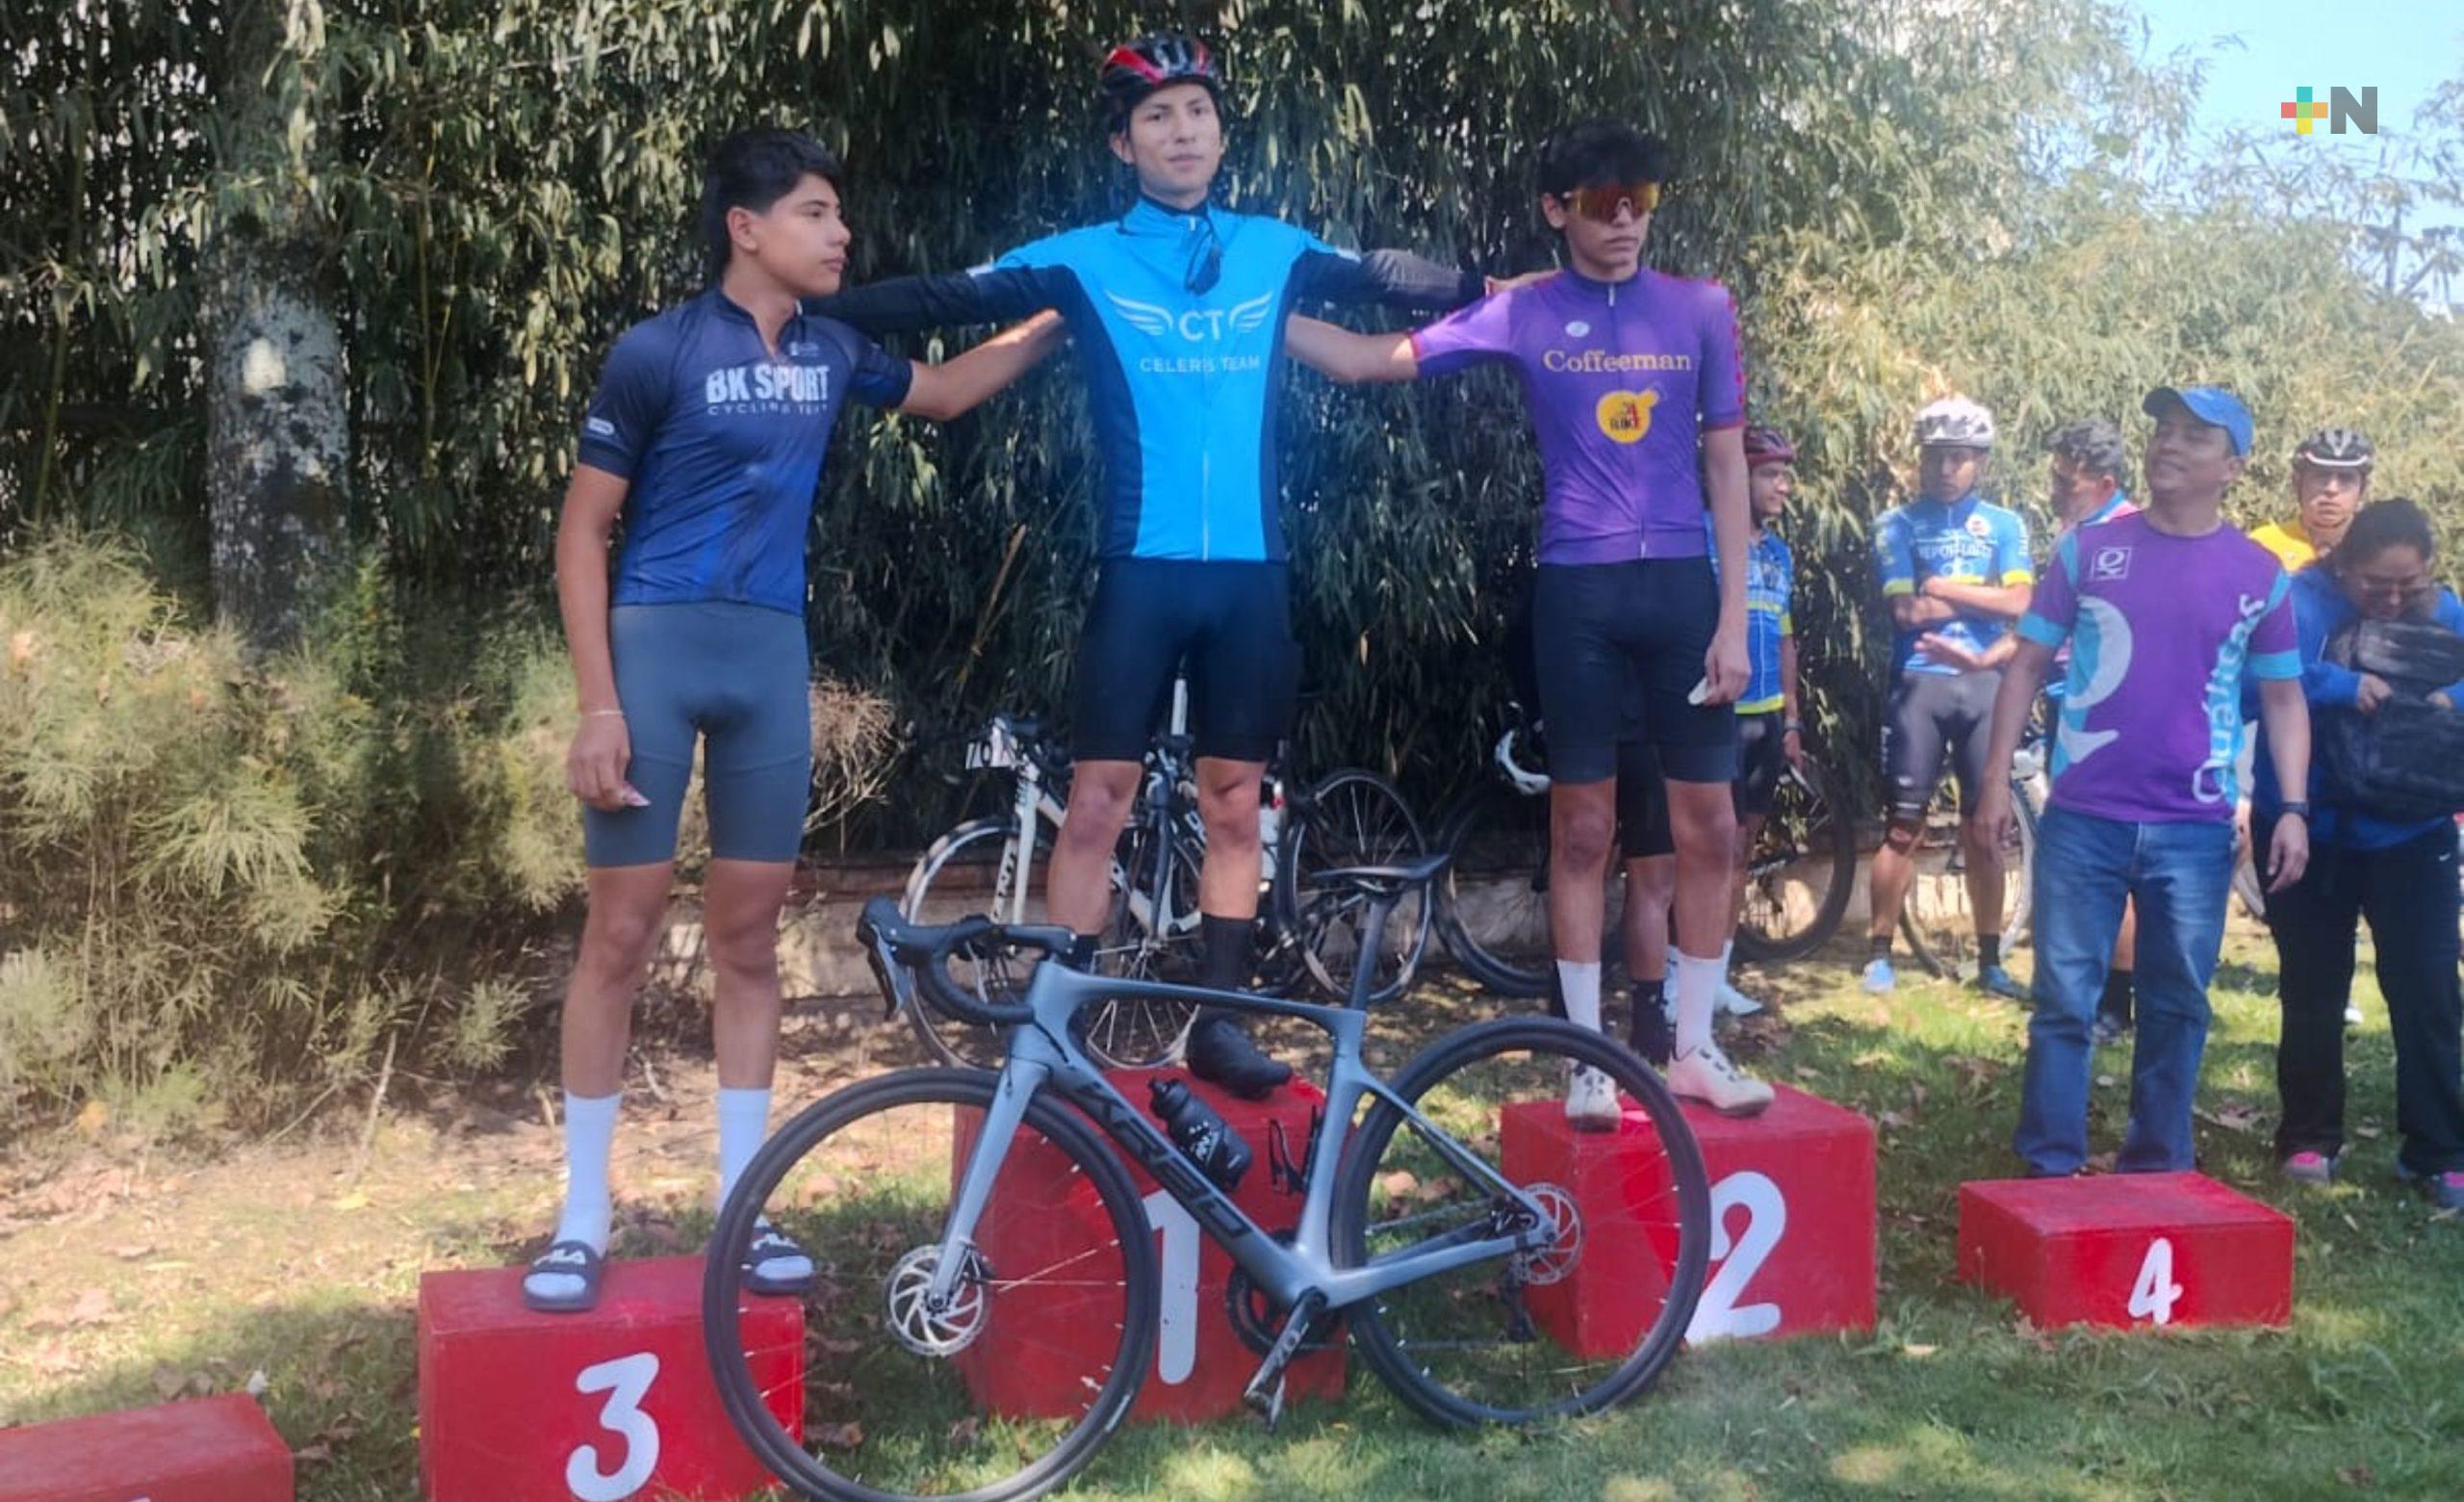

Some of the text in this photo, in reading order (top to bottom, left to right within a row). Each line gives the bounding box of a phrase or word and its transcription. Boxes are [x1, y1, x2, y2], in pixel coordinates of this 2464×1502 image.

[1178, 309, 1223, 341] CT
[1543, 350, 1691, 373] Coffeeman
[706, 363, 830, 403] BK SPORT
[1142, 1189, 1200, 1385] 1
[1685, 1171, 1786, 1345] 2
[2128, 1237, 2183, 1325] 4
[566, 1352, 659, 1502] 3
